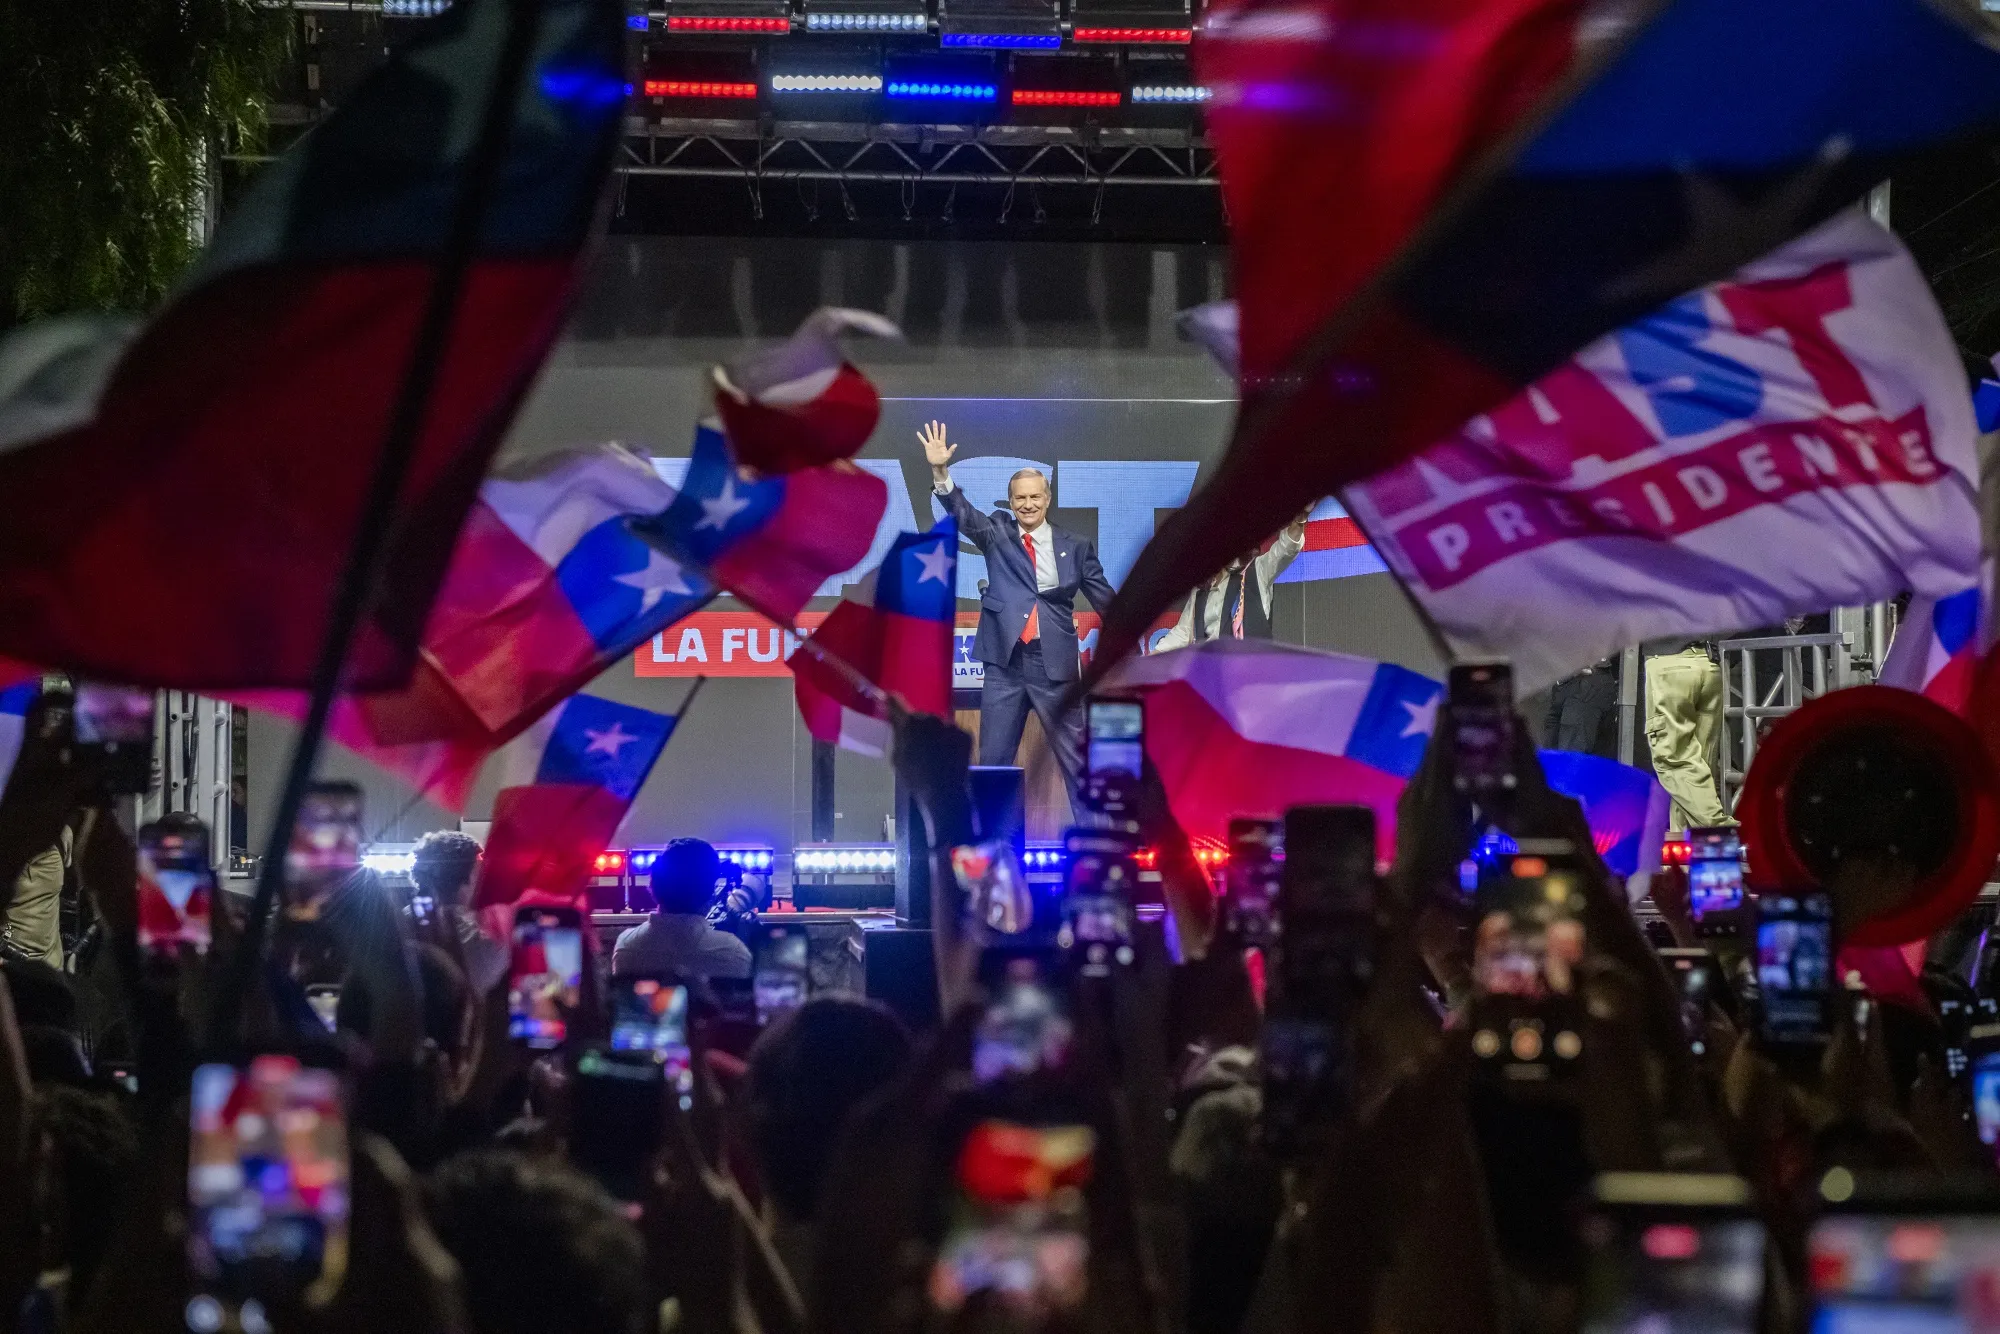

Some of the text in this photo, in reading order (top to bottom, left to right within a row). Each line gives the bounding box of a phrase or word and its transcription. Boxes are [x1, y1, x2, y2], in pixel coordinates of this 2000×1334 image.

[652, 628, 708, 662] LA
[954, 667, 984, 676] LA FU
